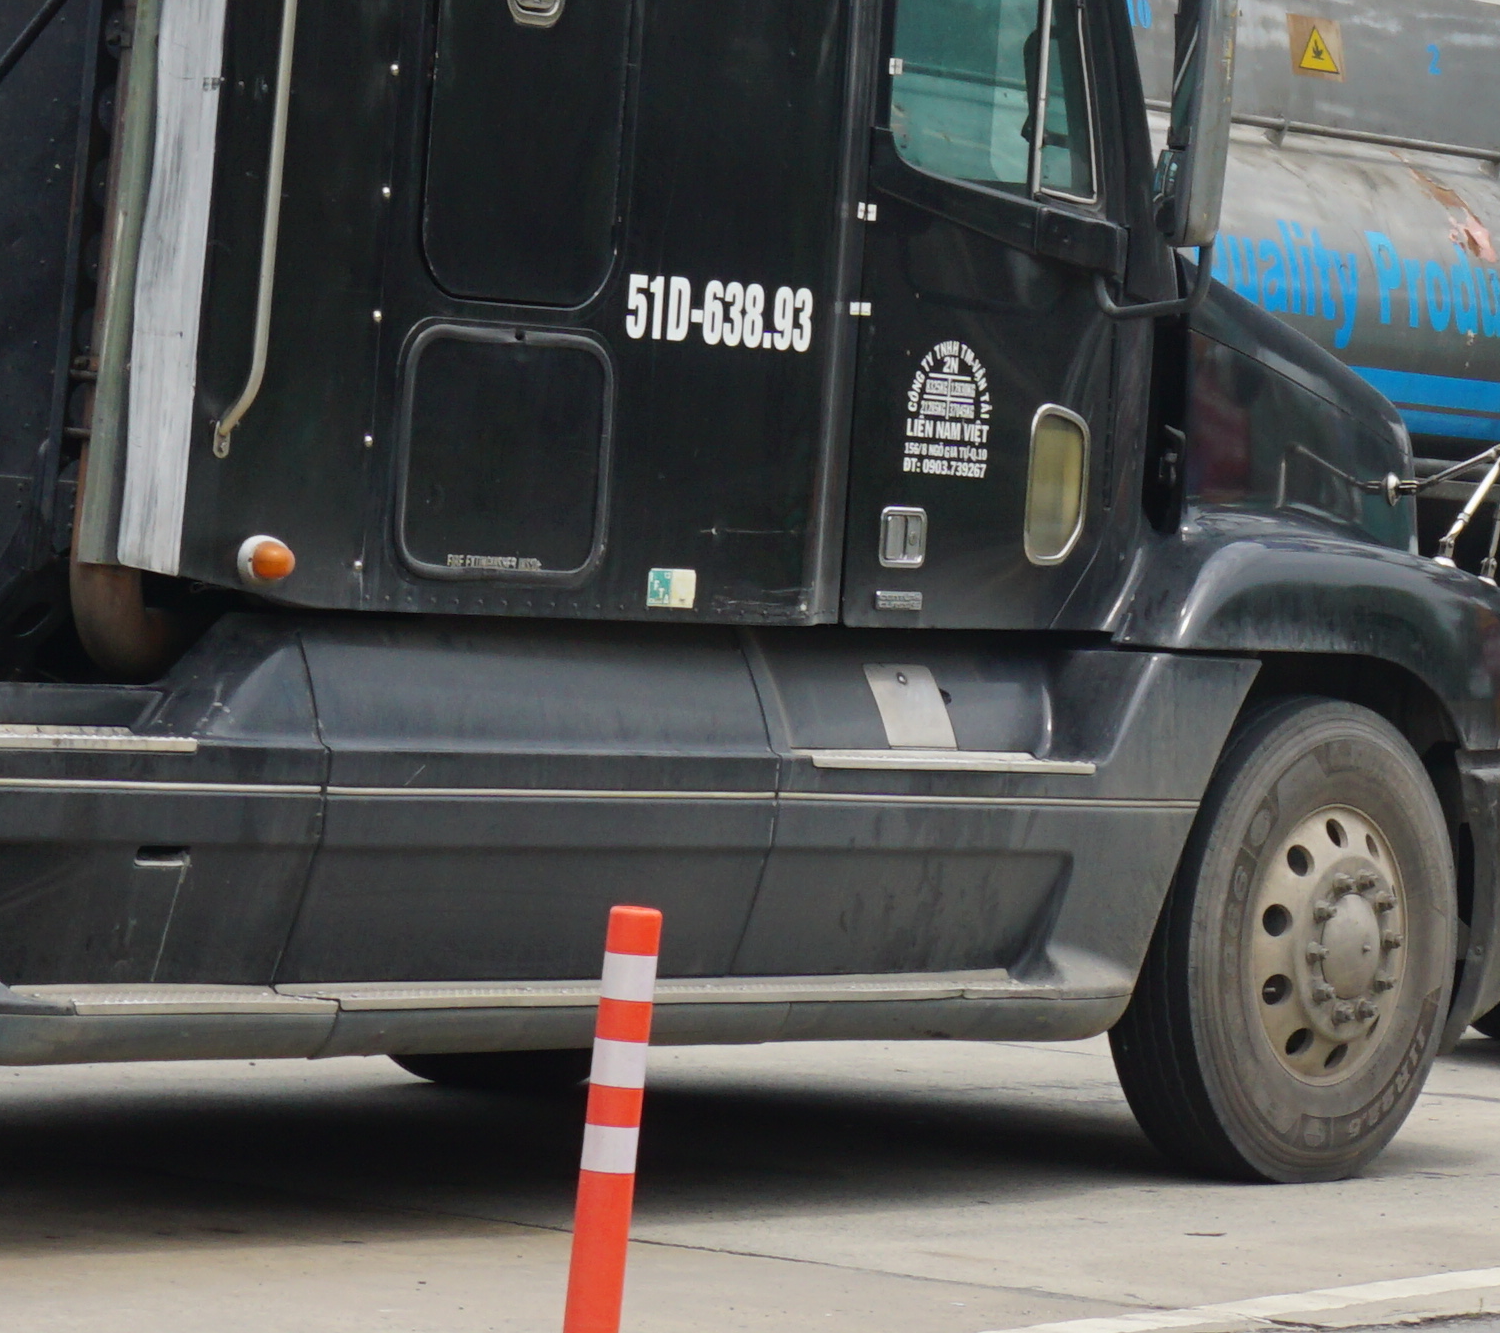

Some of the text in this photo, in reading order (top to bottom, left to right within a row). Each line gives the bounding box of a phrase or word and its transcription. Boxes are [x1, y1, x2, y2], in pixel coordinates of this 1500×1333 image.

[1426, 44, 1443, 76] 2
[625, 273, 814, 353] 51D-638.93
[920, 351, 935, 372] TY
[933, 340, 961, 360] TNHH
[942, 356, 960, 374] 2N
[906, 414, 990, 446] LIÊN NAM VIỆT
[903, 457, 987, 478] ĐT: 0903.739267
